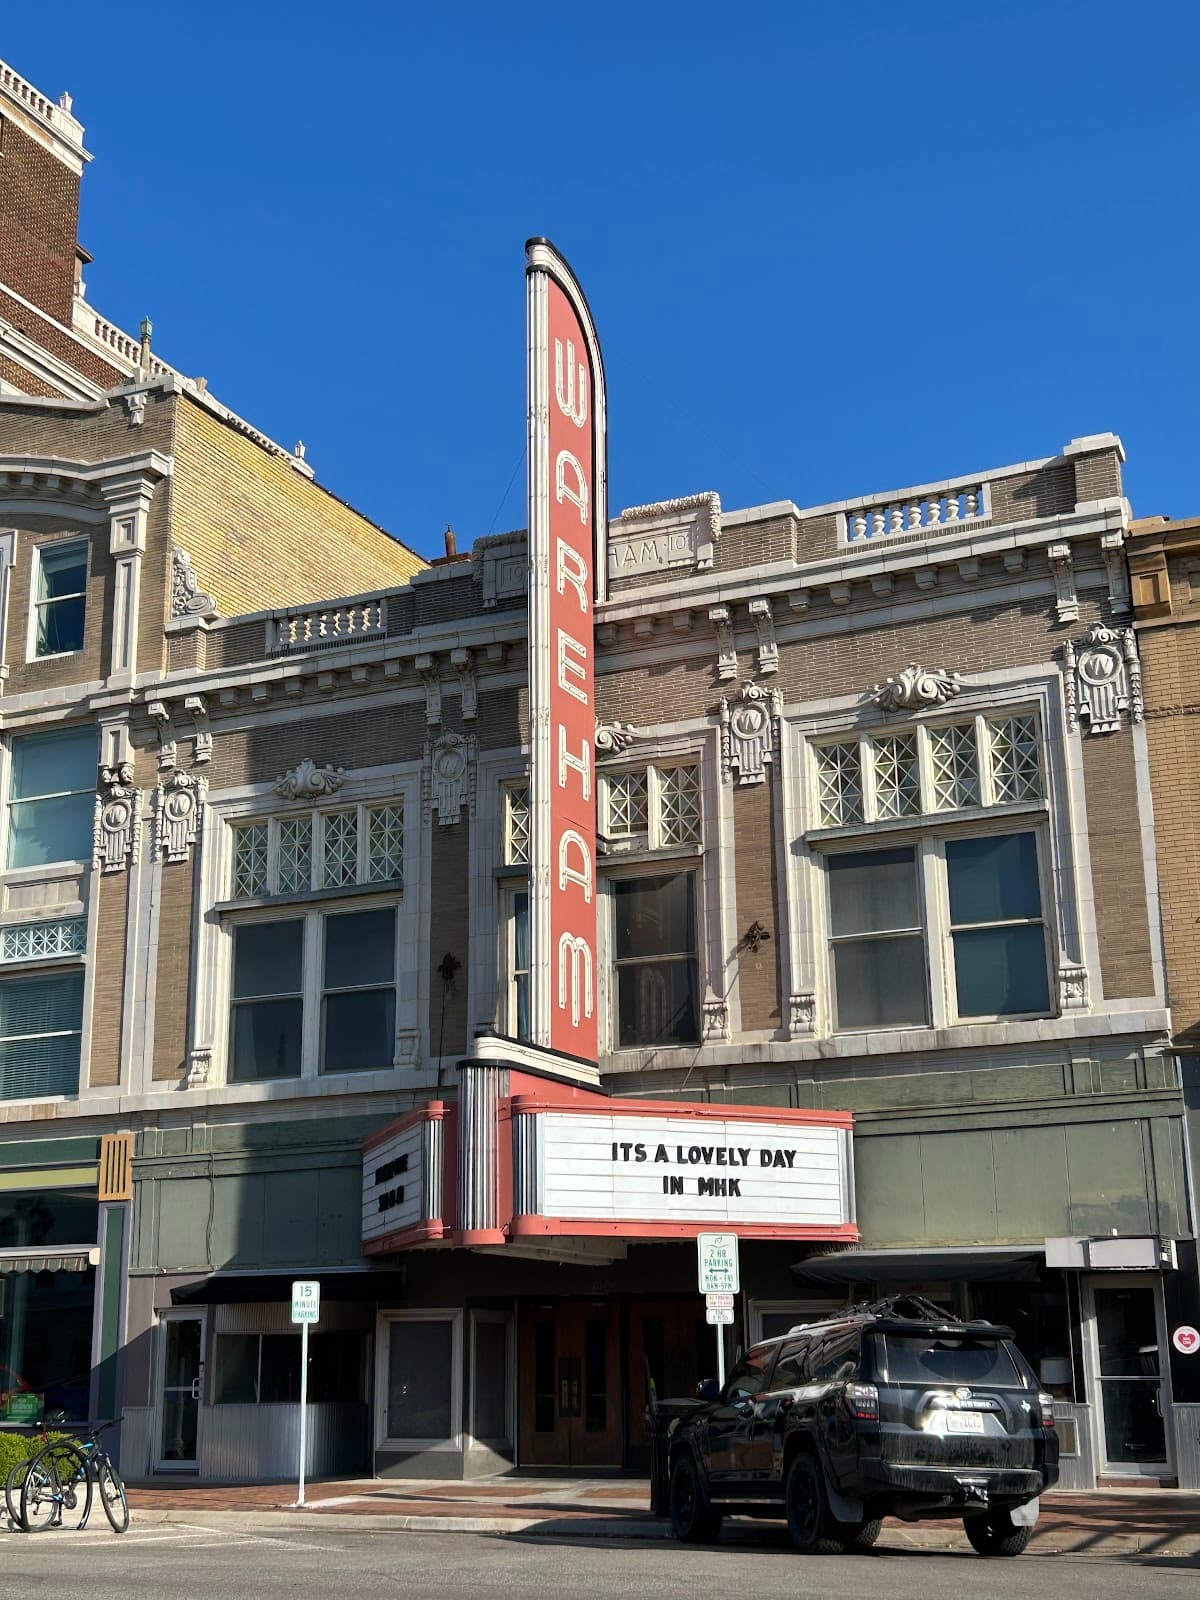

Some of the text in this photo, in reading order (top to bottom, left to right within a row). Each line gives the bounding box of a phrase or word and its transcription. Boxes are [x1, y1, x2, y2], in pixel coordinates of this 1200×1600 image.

[554, 337, 593, 1028] WAREHAM
[611, 1142, 797, 1169] ITS A LOVELY DAY
[662, 1175, 742, 1197] IN MHK
[710, 1249, 727, 1258] 2 HR
[704, 1258, 733, 1268] PARKING
[300, 1286, 312, 1297] 15
[294, 1300, 317, 1309] MINUTE
[294, 1311, 317, 1319] PARKING
